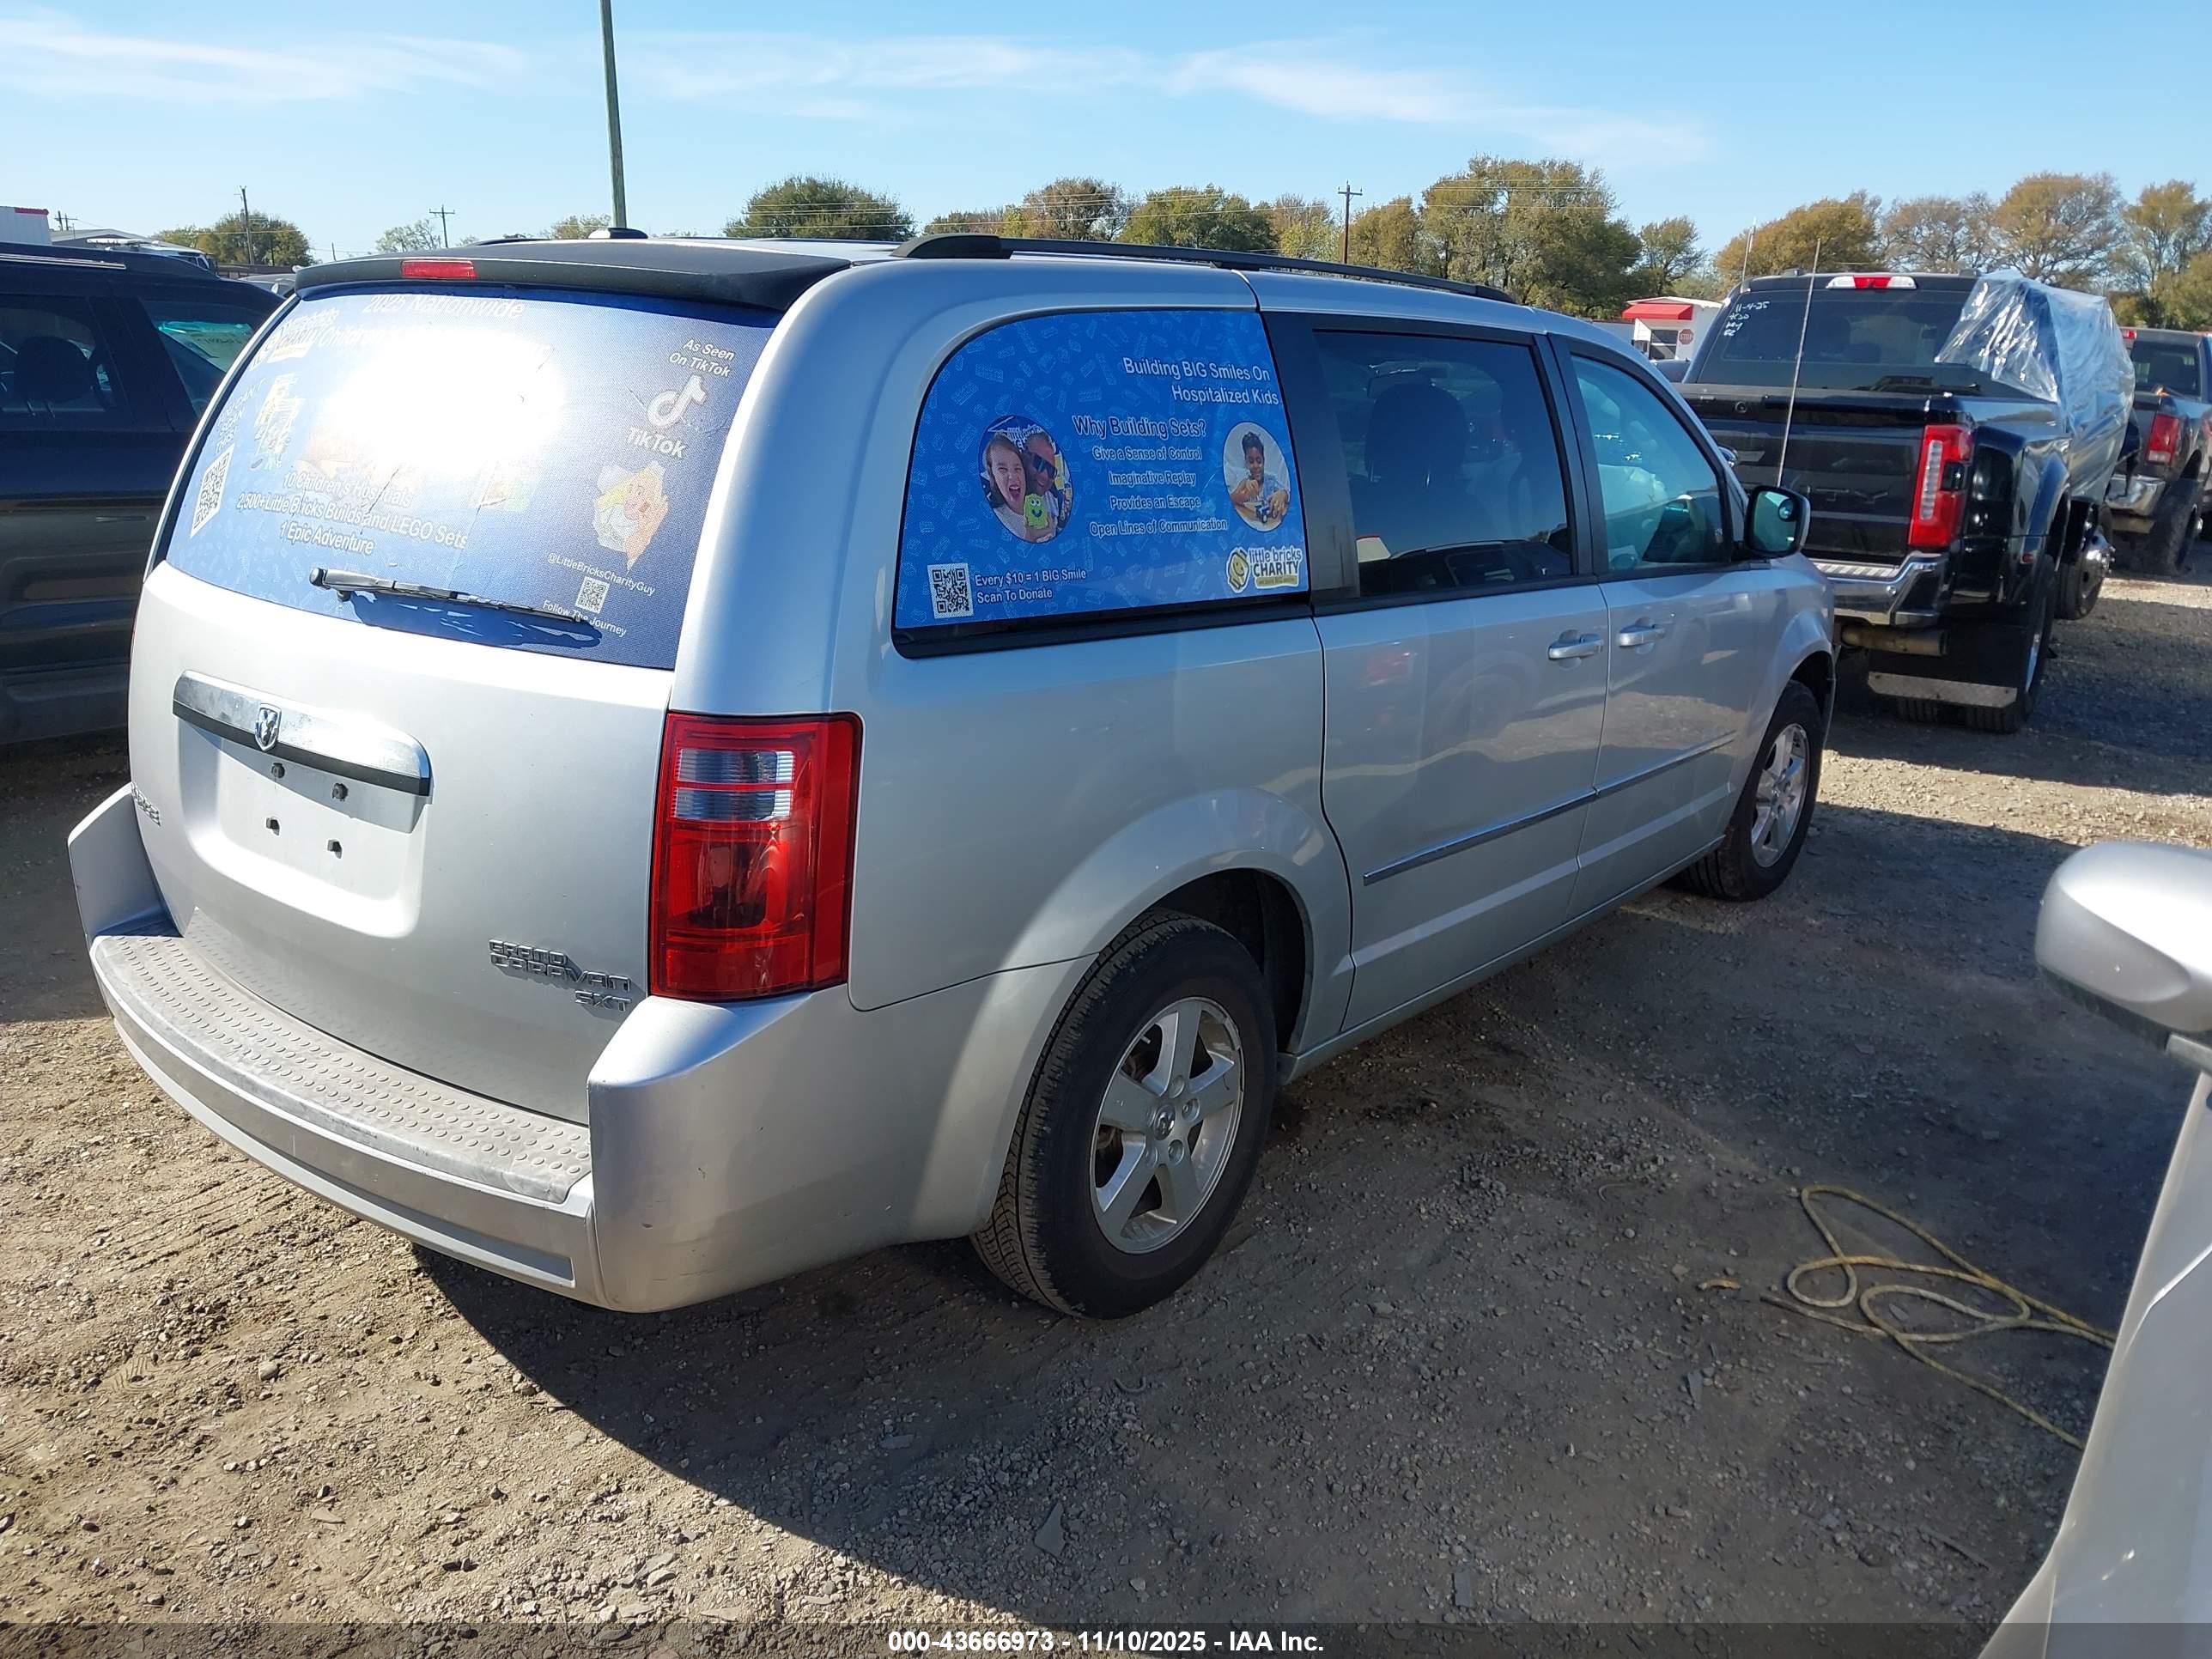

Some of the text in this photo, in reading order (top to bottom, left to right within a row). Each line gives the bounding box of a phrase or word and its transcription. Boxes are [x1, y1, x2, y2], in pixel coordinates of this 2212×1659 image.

[408, 295, 524, 319] Nationwide
[1735, 301, 1771, 313] 11-4-25
[683, 339, 735, 361] As Seen
[669, 352, 732, 377] On TikTok
[1123, 357, 1270, 380] Building BIG Smiles On
[1171, 385, 1279, 405] Hospitalized Kids
[1072, 416, 1106, 440] Why
[1108, 416, 1169, 441] Building
[1170, 418, 1206, 438] Sets?
[626, 426, 686, 459] TikTok
[1092, 446, 1203, 461] Give a Sense of Control
[283, 472, 296, 489] 10
[296, 472, 350, 496] Children's
[1109, 471, 1197, 488] Imaginative Replay
[1109, 495, 1201, 510] Provides an Escape
[236, 493, 467, 549] 2,500+ Little Bricks Builds and LEGO Sets
[1090, 517, 1228, 538] Open Lines of Communication
[281, 521, 374, 555] 1 Epic Adventure
[1249, 547, 1302, 563] little bricks
[547, 552, 656, 597] @LittleBricksCharityGuy
[975, 574, 1003, 587] Every
[1006, 572, 1024, 586] $10
[1034, 571, 1039, 582] 1
[1042, 569, 1060, 582] BIG
[1060, 568, 1086, 581] Smile
[1253, 561, 1298, 577] CHARITY
[977, 587, 1053, 604] Scan To Donate
[542, 599, 571, 616] Follow
[589, 617, 628, 638] Journey
[489, 939, 567, 965] GRAND
[489, 952, 632, 993] CARAVAN
[574, 989, 633, 1012] SXT
